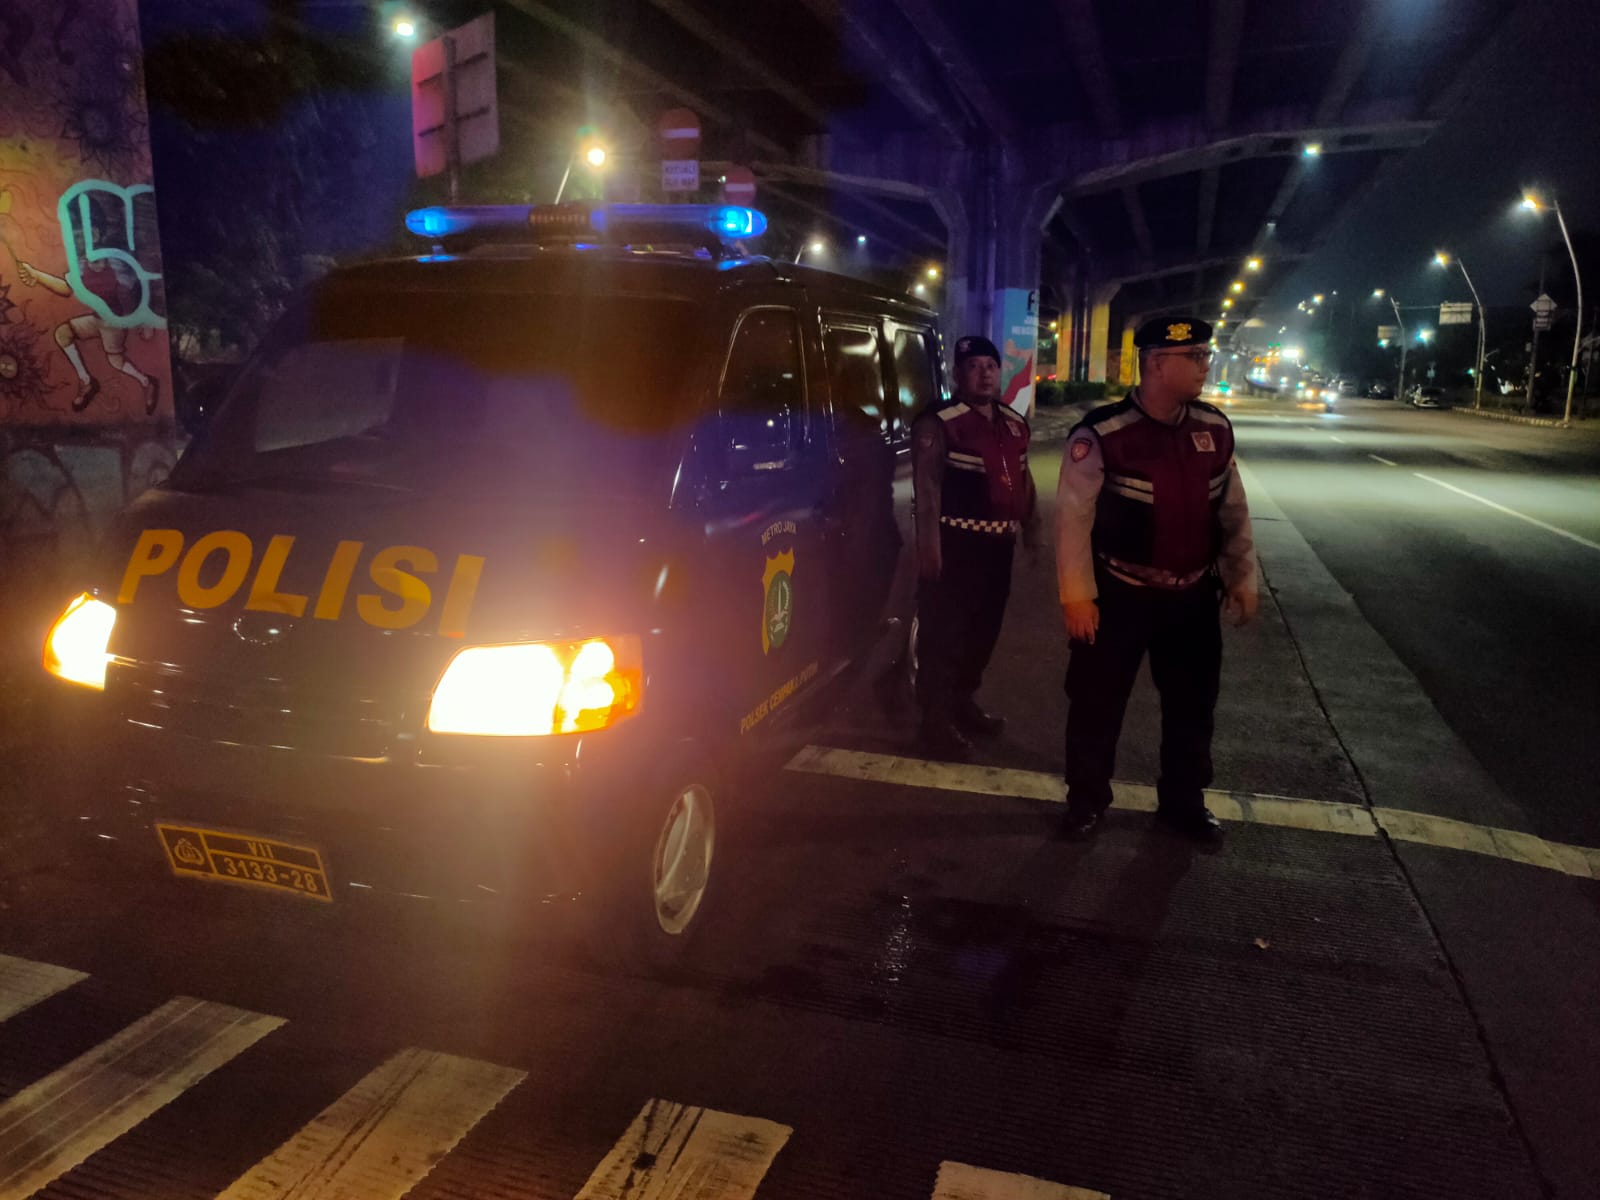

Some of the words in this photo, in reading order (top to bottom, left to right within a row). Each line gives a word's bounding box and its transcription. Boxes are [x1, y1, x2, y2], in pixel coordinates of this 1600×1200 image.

[761, 521, 783, 546] METRO
[117, 529, 486, 638] POLISI
[247, 841, 275, 859] VII
[223, 857, 318, 892] 3133-28
